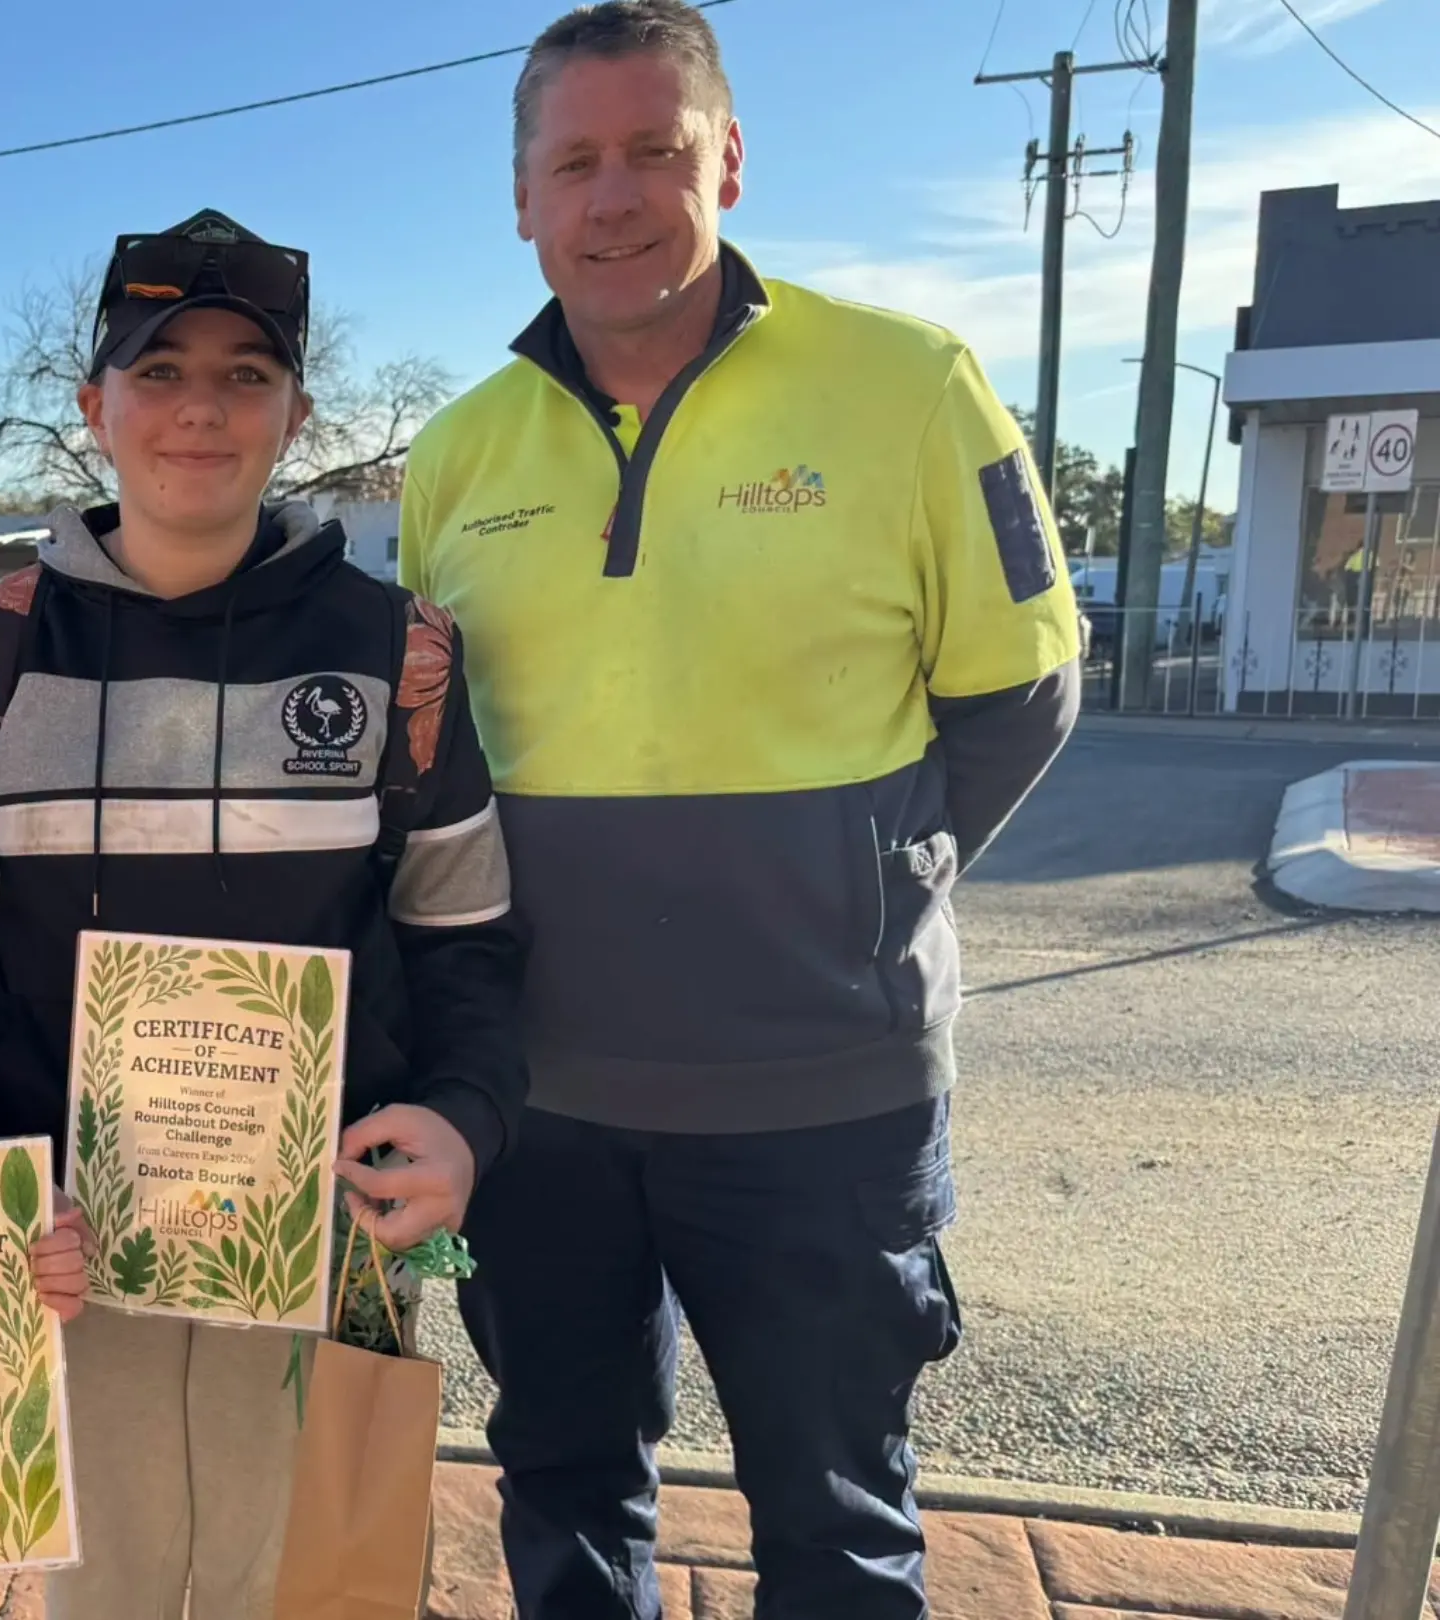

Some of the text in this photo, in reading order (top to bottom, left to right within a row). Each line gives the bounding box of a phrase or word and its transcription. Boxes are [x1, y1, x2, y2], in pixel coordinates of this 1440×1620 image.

[1377, 438, 1408, 462] 40
[718, 481, 826, 513] Hilltops
[478, 519, 529, 536] Controller
[287, 761, 358, 772] SCHOOL SPORT
[133, 1019, 285, 1050] CERTIFICATE
[194, 1044, 217, 1058] OF
[130, 1055, 280, 1084] ACHIEVEMENT
[180, 1085, 226, 1098] Winner of
[148, 1097, 256, 1118] Hilltops Council
[134, 1111, 265, 1136] Roundabout Design
[166, 1129, 232, 1148] Challenge
[162, 1147, 200, 1161] Careers
[202, 1151, 228, 1164] Expo
[138, 1163, 256, 1187] Dakota Bourke
[138, 1196, 238, 1238] Hilltops
[159, 1226, 203, 1238] COUNCIL
